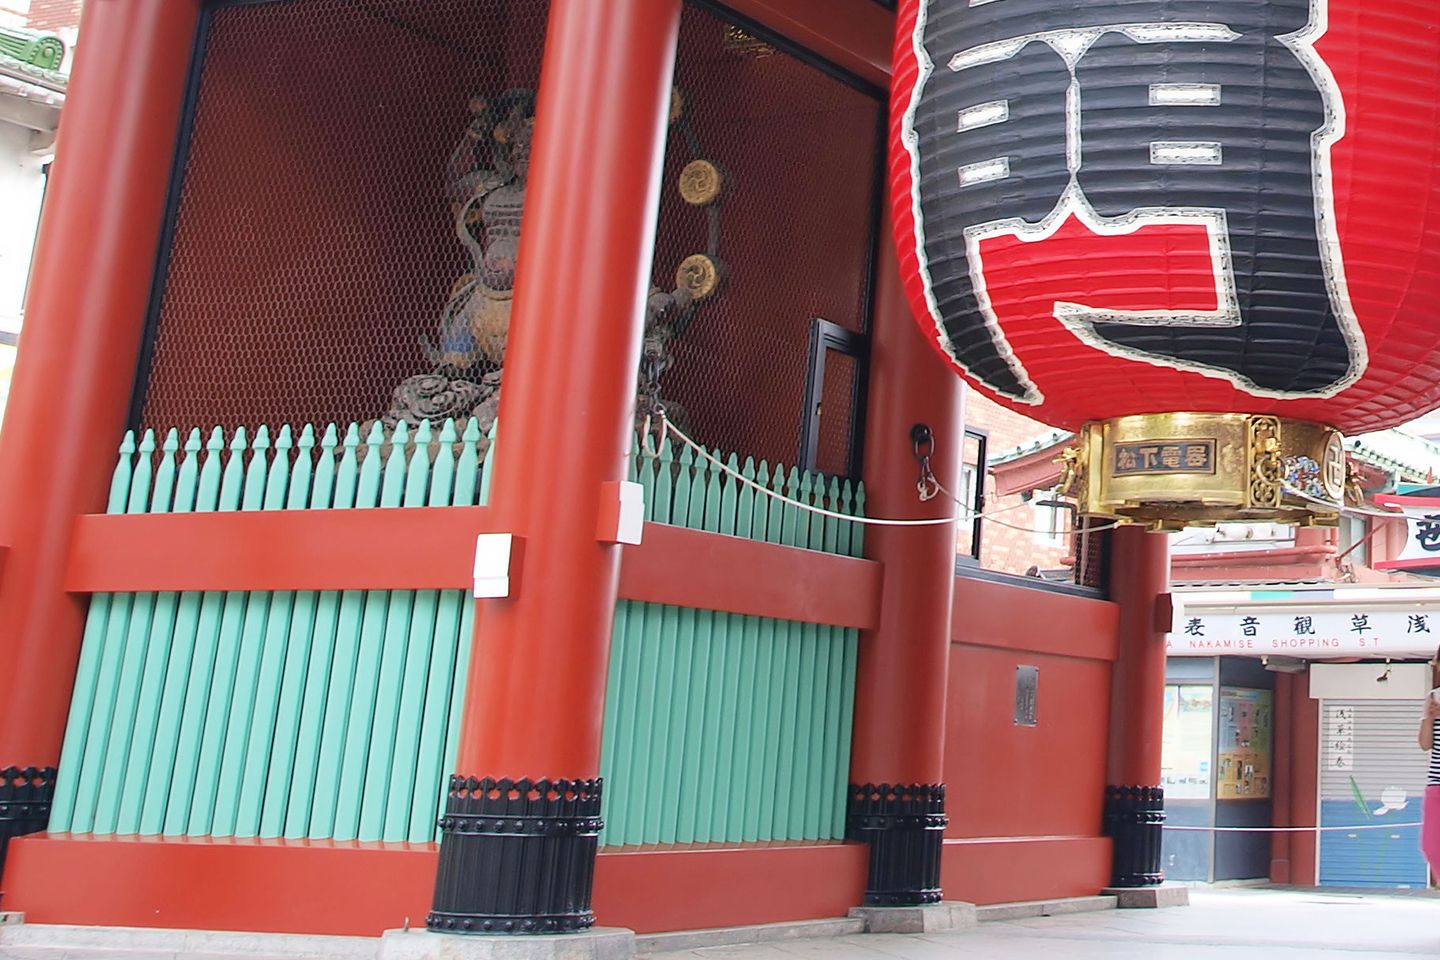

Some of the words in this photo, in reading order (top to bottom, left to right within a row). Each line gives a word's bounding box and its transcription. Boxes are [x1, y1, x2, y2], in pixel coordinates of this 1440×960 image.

[1118, 444, 1207, 469] 松下電器
[1189, 639, 1253, 649] NAKAMISE
[1272, 638, 1339, 648] SHOPPING
